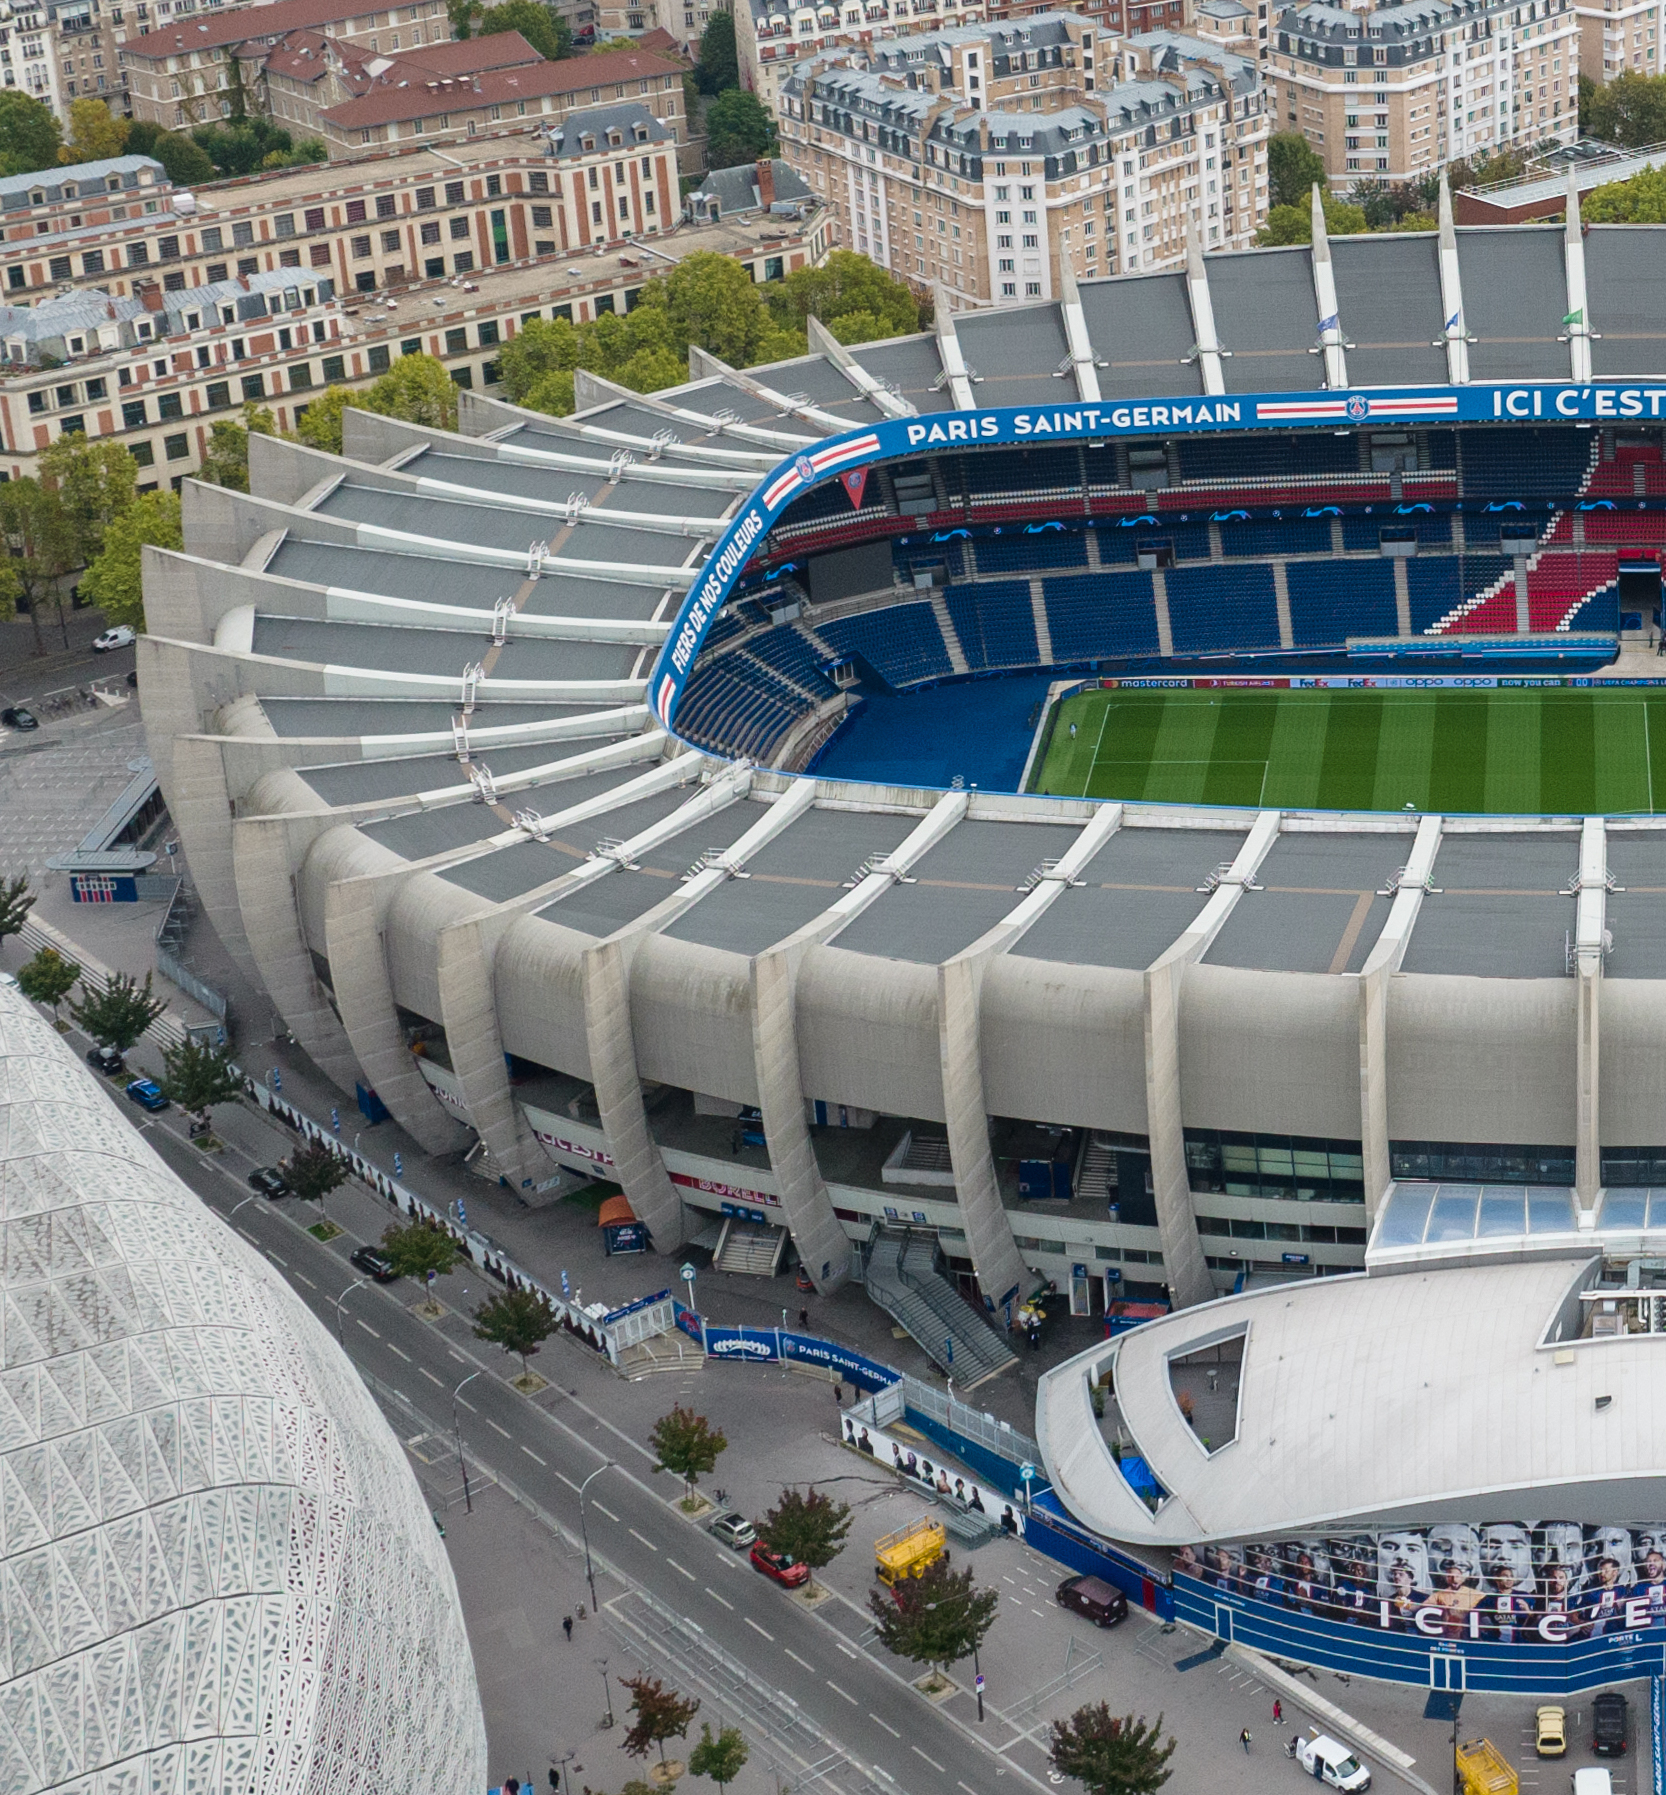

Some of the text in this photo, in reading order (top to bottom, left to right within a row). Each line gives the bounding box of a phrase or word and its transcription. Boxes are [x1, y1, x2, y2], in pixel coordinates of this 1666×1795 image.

[1493, 389, 1541, 417] ICI
[1556, 388, 1666, 417] C'EST
[907, 402, 1241, 446] PARIS SAINT-GERMAIN
[671, 509, 763, 675] FIERS DE NOS COULEURS
[1121, 679, 1188, 688] mastercard
[1300, 679, 1328, 688] FedEx
[1349, 679, 1377, 688] FedEx
[1405, 678, 1444, 688] oppo
[1453, 678, 1492, 688] oppo
[1501, 679, 1561, 688] now you can
[799, 1345, 830, 1360] PARIS
[1608, 1633, 1643, 1644] PORTE L
[1653, 1675, 1661, 1761] SAINT-GERMAIN
